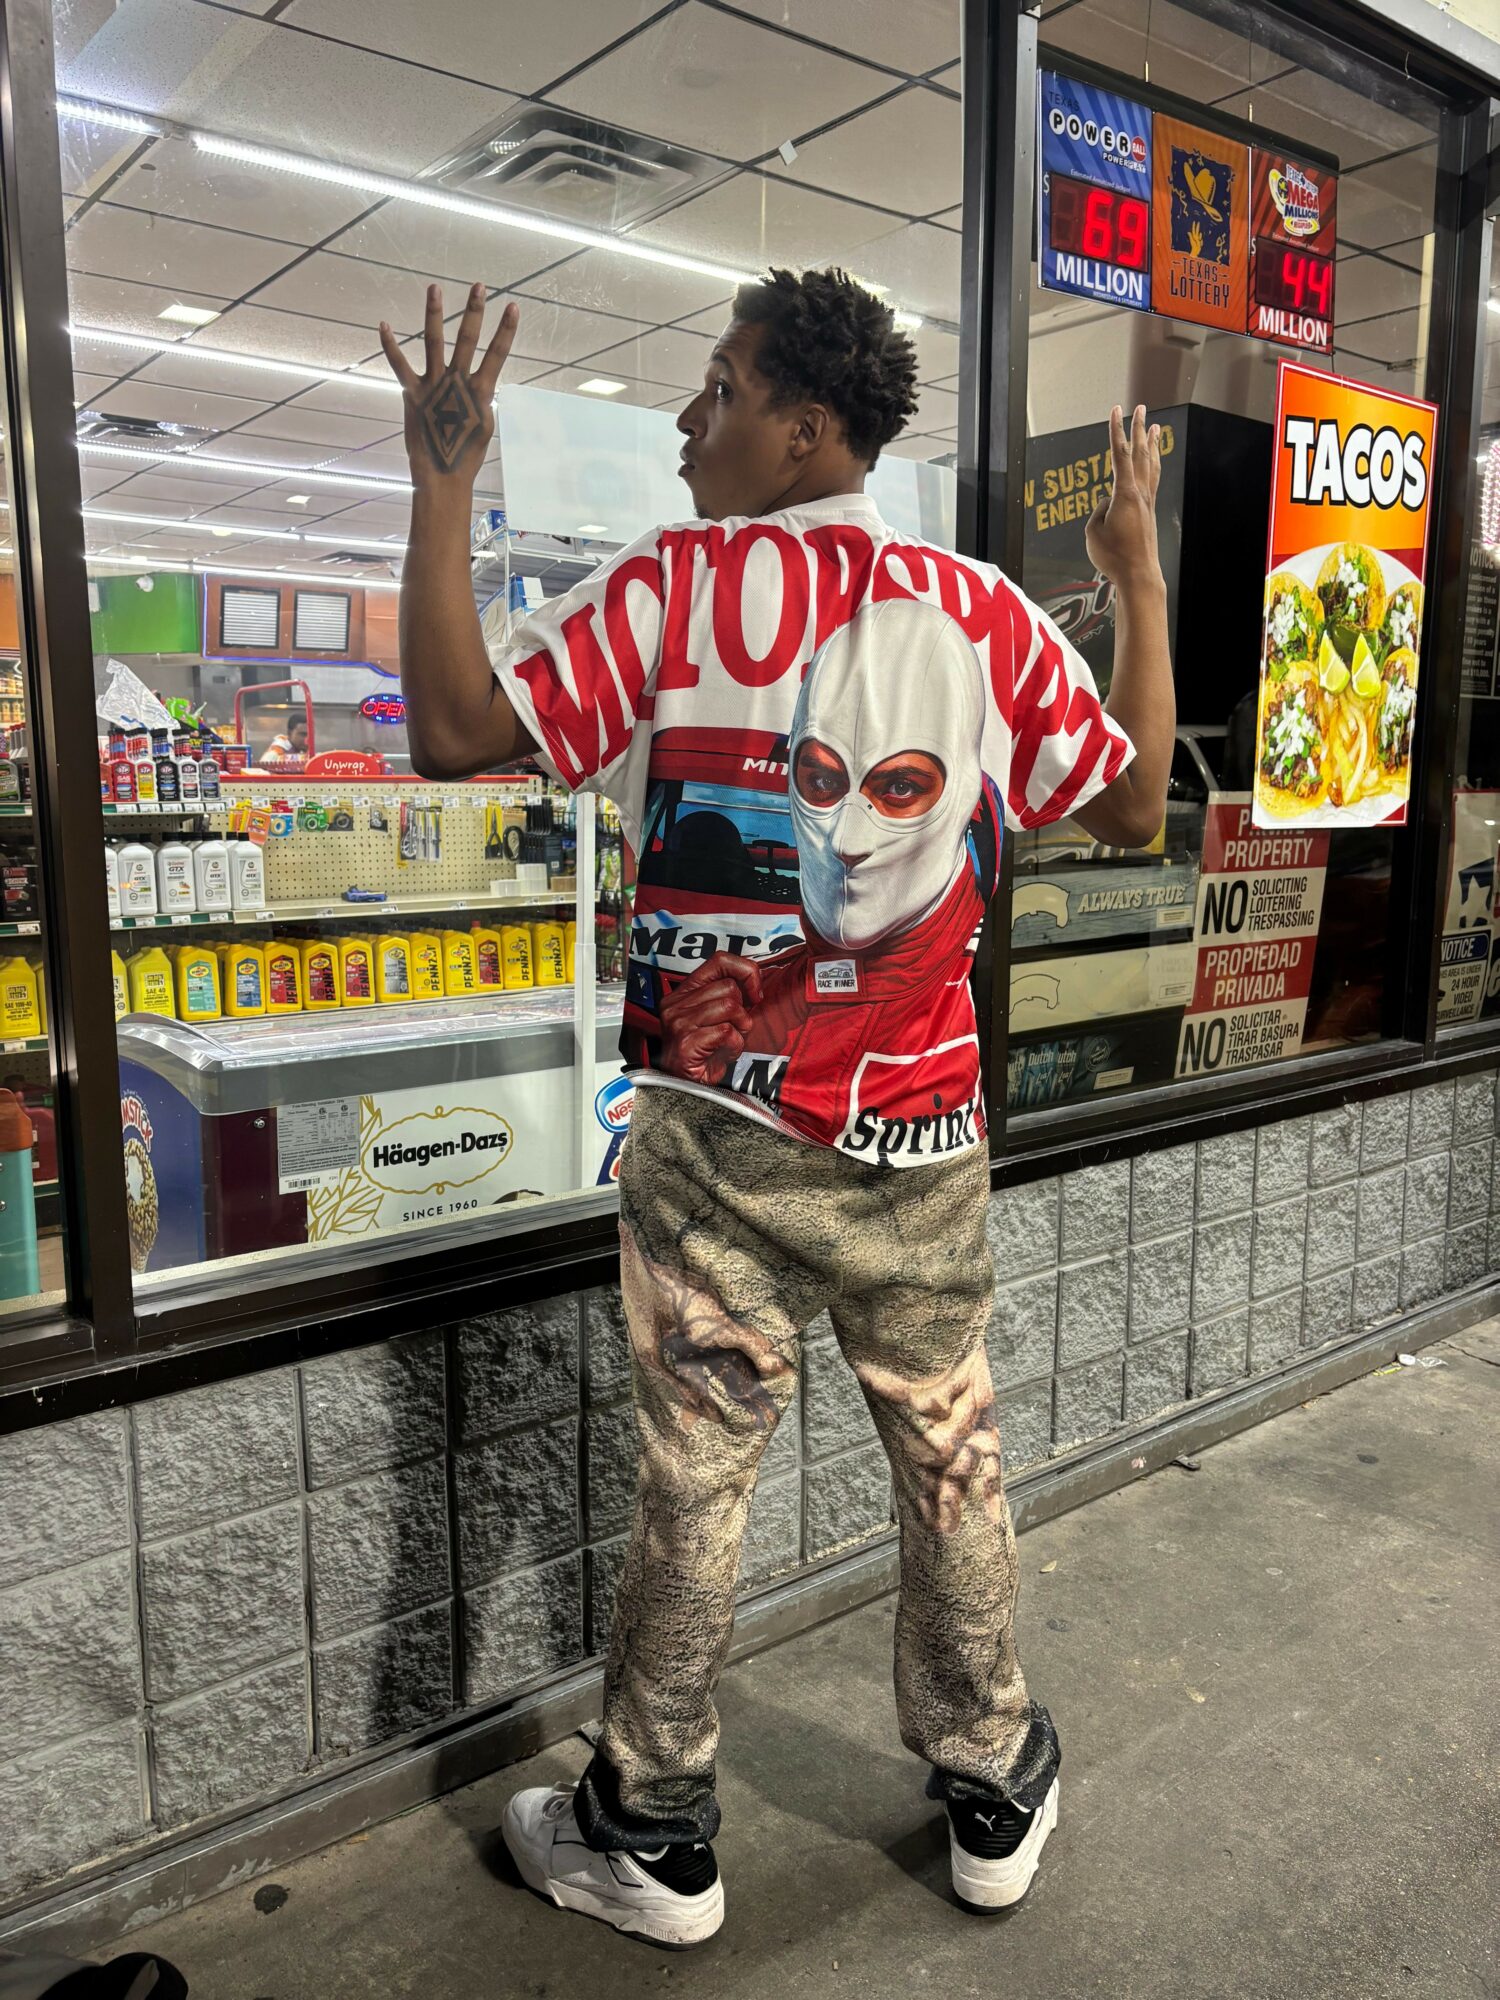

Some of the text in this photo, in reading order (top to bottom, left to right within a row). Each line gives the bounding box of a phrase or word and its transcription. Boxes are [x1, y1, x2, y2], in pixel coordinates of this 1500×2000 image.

[1048, 91, 1080, 112] TEXAS
[1286, 180, 1318, 210] MEGA
[1284, 205, 1319, 218] MILLIONS
[1083, 190, 1147, 267] 69
[1056, 253, 1142, 301] MILLION
[1183, 257, 1218, 282] TEXAS
[1283, 252, 1329, 314] 44
[1171, 270, 1230, 308] LOTTERY
[1259, 306, 1327, 346] MILLION
[1284, 415, 1427, 512] TACOS
[324, 759, 365, 772] Unwrap
[1223, 838, 1314, 869] PROPERTY
[1077, 884, 1187, 914] ALWAYS TRUE
[1252, 876, 1308, 896] SOLICITING
[1201, 880, 1249, 936] NO
[1250, 895, 1303, 914] LOITERING
[1248, 910, 1315, 932] TRESPASSING
[1205, 941, 1302, 979] PROPIEDAD
[817, 979, 856, 988] RACE WINNER
[1213, 972, 1286, 1007] PRIVADA
[1451, 976, 1480, 991] 24 HOUR
[1453, 991, 1473, 1005] VIDEO
[1230, 1009, 1282, 1032] SOLICITAR
[1179, 1017, 1227, 1074] NO
[1228, 1022, 1299, 1049] TIRAR BASURA
[1028, 1049, 1054, 1066] Dutch
[1057, 1050, 1077, 1064] utch
[1225, 1041, 1283, 1066] TRASPASAR
[842, 1093, 975, 1168] Sprint
[373, 1132, 507, 1168] Häagen-Dazs
[403, 1199, 478, 1221] SINCE 1960
